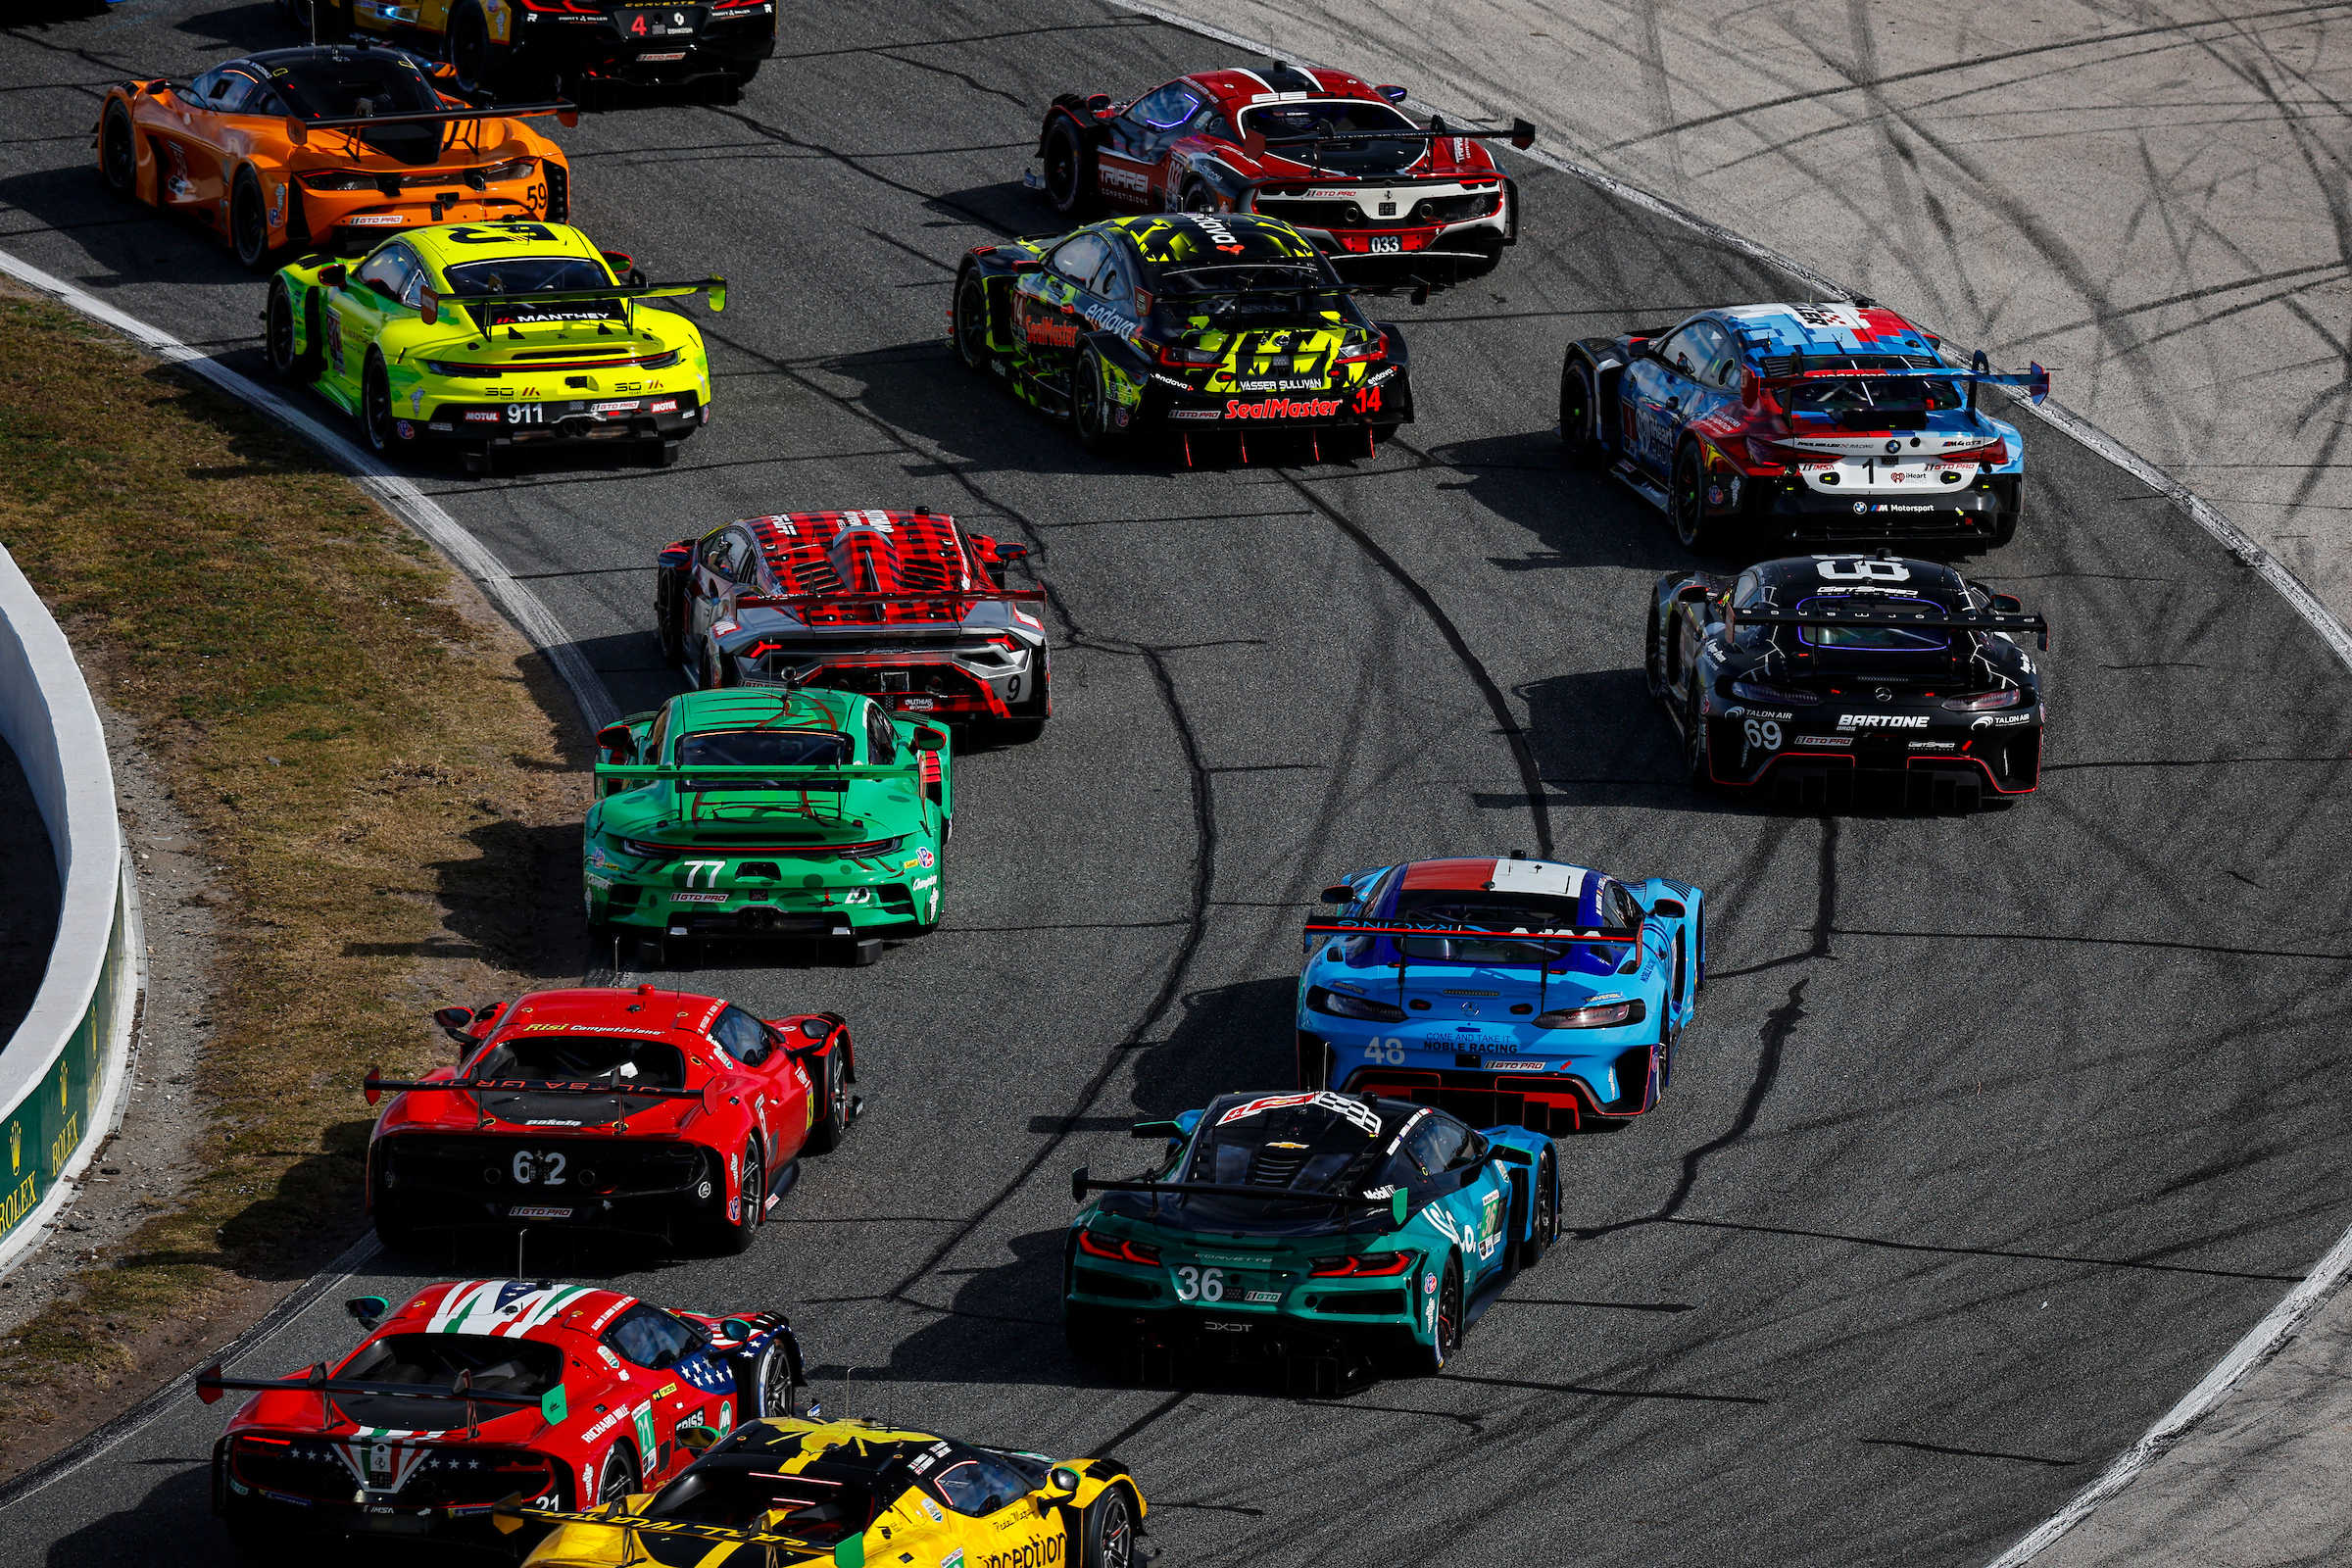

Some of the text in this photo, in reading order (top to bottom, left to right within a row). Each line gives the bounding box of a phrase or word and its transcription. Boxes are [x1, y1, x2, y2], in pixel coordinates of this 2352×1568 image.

[630, 14, 647, 35] 4
[1099, 163, 1150, 194] TRIARSI
[526, 182, 548, 212] 59
[1101, 186, 1150, 207] COMPETIZIONE
[1371, 236, 1399, 253] 033
[517, 312, 610, 322] MANTHEY
[1012, 294, 1023, 323] 14
[1025, 315, 1079, 348] SealMaster
[1084, 302, 1137, 342] endava
[1154, 372, 1189, 390] endava
[1240, 378, 1322, 391] VASSER SULLIVAN
[1367, 367, 1394, 386] endava
[485, 387, 514, 397] 30
[1356, 385, 1382, 414] 14
[466, 412, 499, 421] MOTUL
[507, 403, 544, 424] 911
[652, 401, 677, 413] MOTUL
[1225, 399, 1340, 419] SealMaster
[1649, 414, 1674, 449] iHeart
[1862, 458, 1874, 484] 1
[1891, 504, 1935, 513] Motorsport
[1005, 674, 1021, 701] 9
[1745, 709, 1792, 719] TALON AIR
[1838, 714, 1931, 728] BARTONE
[1994, 713, 2031, 725] TALON AIR
[1743, 718, 1783, 751] 69
[1829, 737, 1852, 746] PRO
[683, 859, 727, 889] 77
[912, 874, 938, 893] Champion
[703, 893, 727, 903] PRO
[523, 1023, 662, 1036] Risi Competizione
[1426, 1033, 1453, 1043] COME
[1454, 1033, 1475, 1043] AND
[1477, 1034, 1499, 1043] TAKE
[1364, 1036, 1405, 1065] 48
[1423, 1041, 1518, 1054] NOBLE RACING
[524, 1118, 582, 1128] pakelo
[52, 1110, 79, 1177] ROLEX
[513, 1150, 566, 1185] 62
[0, 1170, 38, 1237] ROLEX
[546, 1207, 570, 1217] PRO
[1481, 1201, 1498, 1239] 36
[1194, 1251, 1274, 1264] CORVETTE
[1177, 1265, 1224, 1302] 36
[1255, 1292, 1278, 1300] GTD
[581, 1402, 631, 1445] RICHARD MILLE
[637, 1413, 653, 1454] 21
[370, 1505, 395, 1514] IMSA
[536, 1494, 560, 1513] 21
